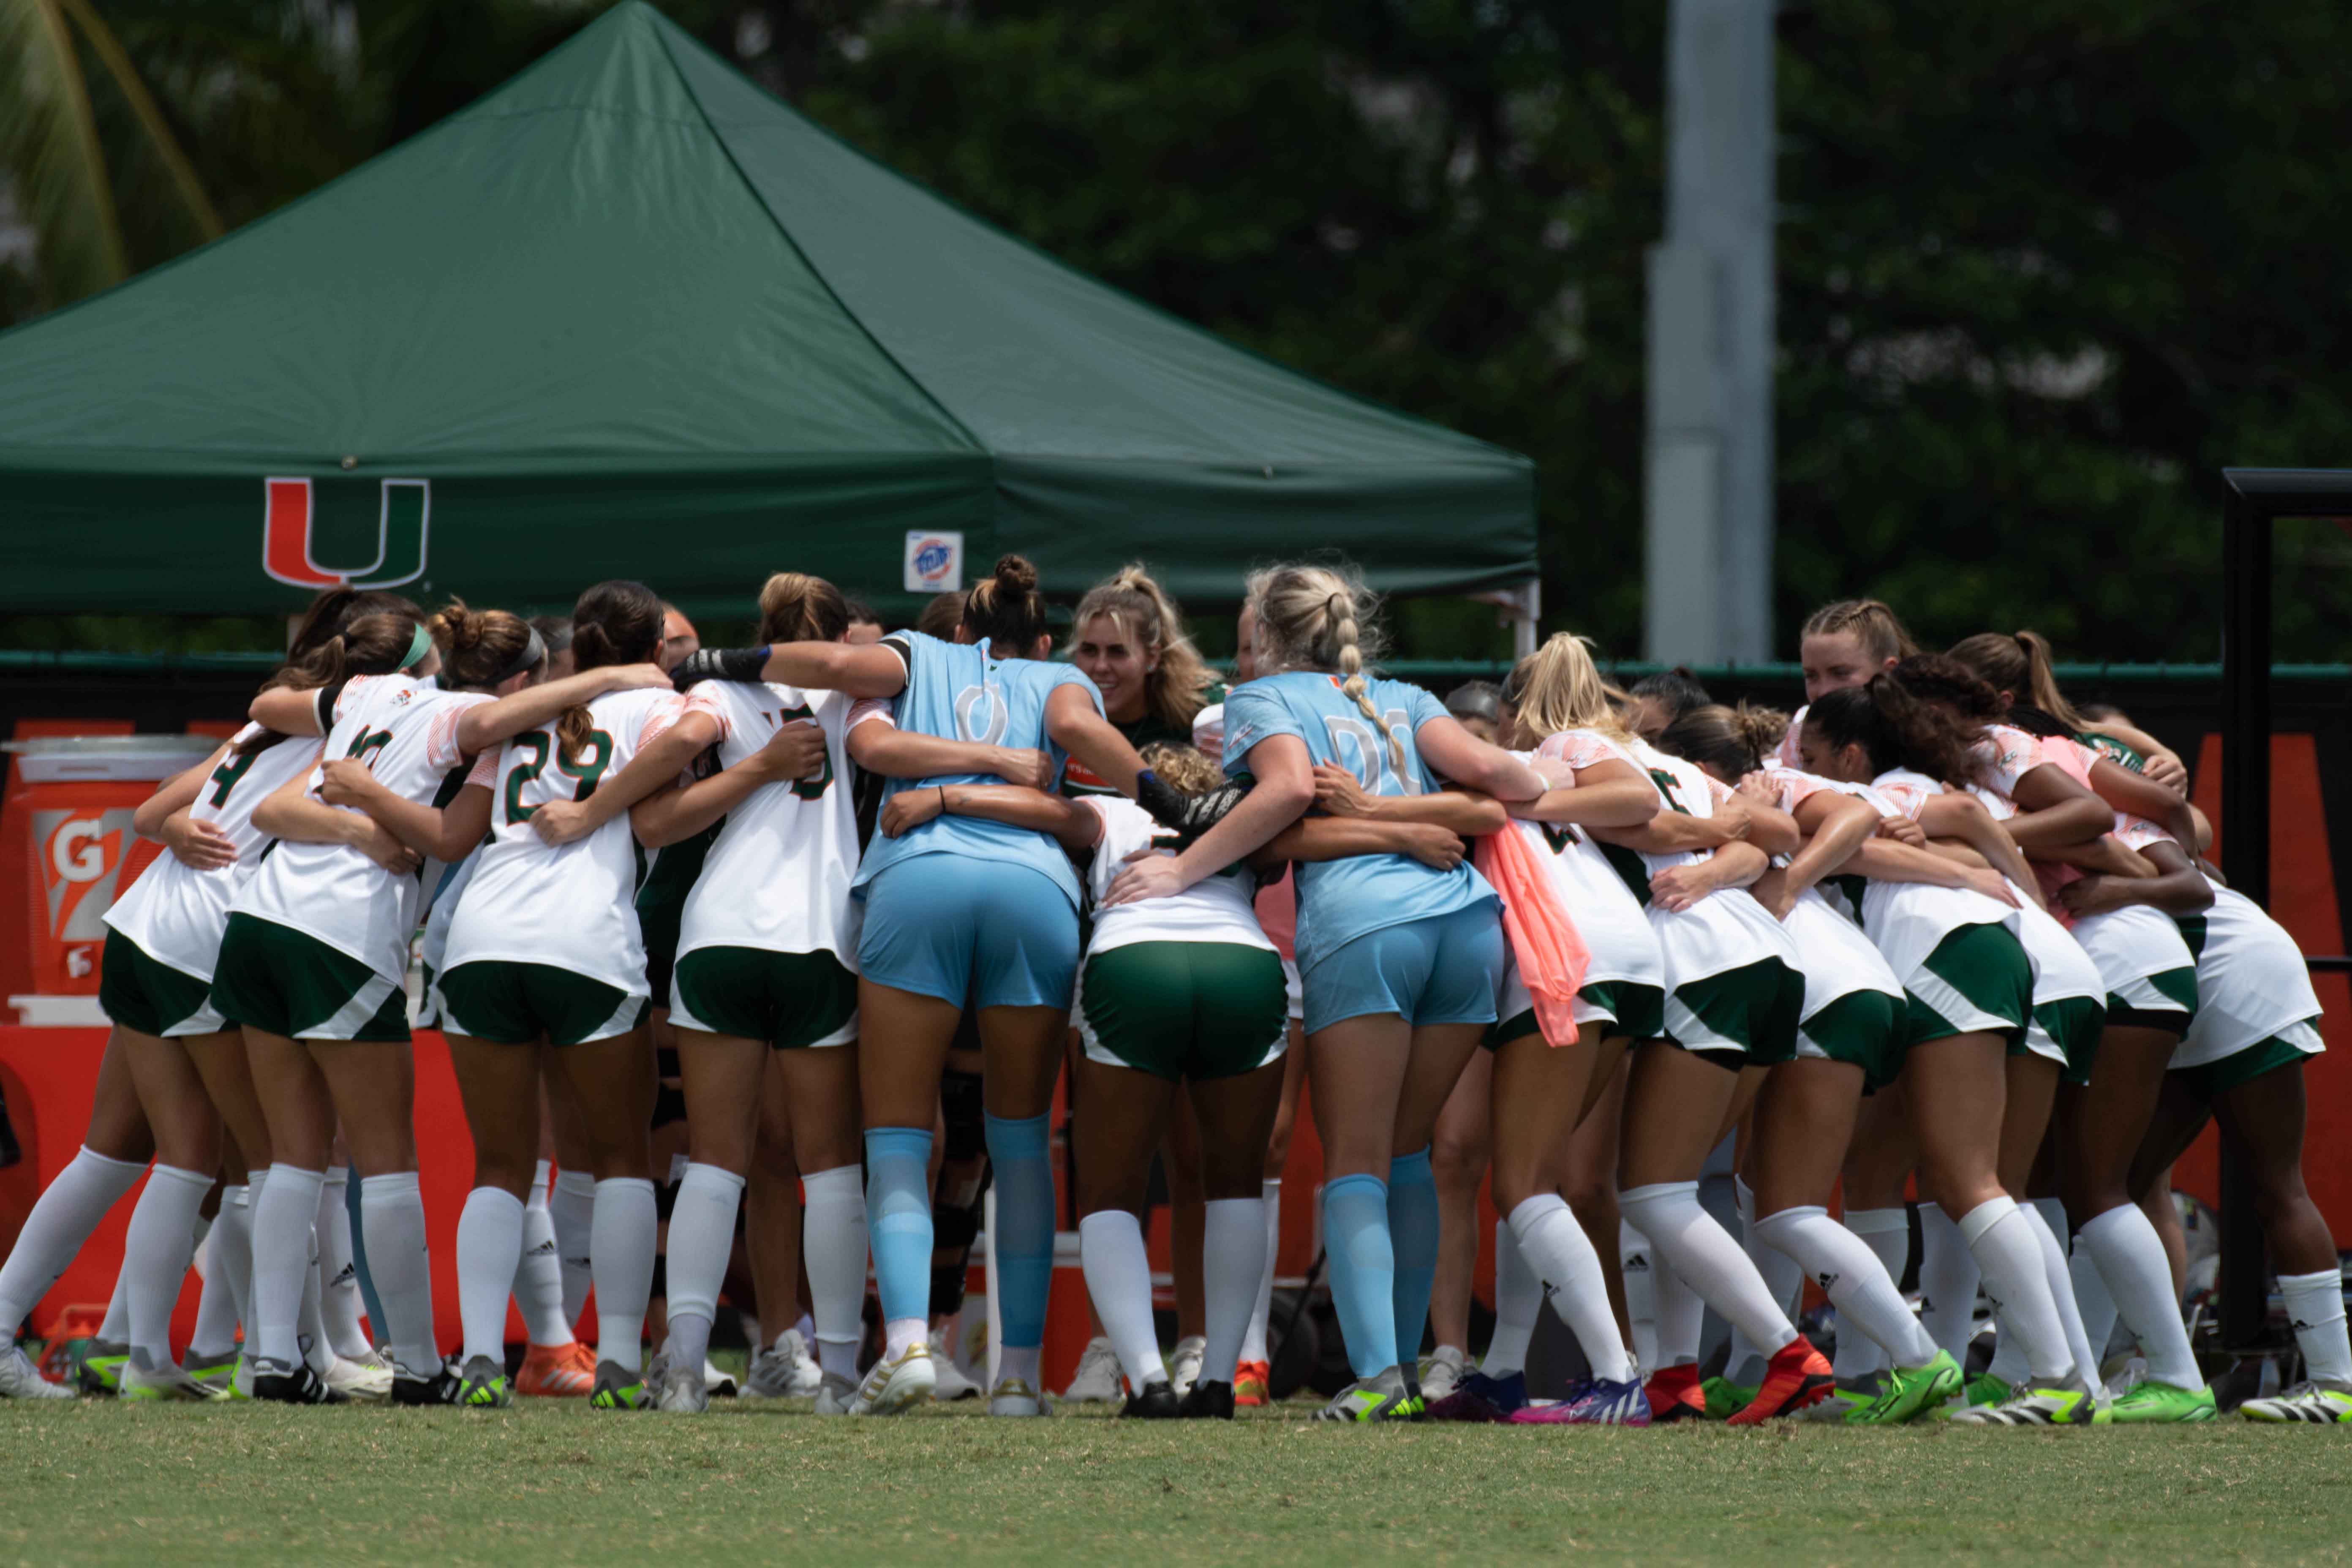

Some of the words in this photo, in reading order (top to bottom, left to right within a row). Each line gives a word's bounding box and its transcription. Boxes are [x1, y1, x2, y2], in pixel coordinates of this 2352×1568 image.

[263, 476, 430, 591] U
[505, 728, 614, 828] 29
[53, 819, 104, 883] G
